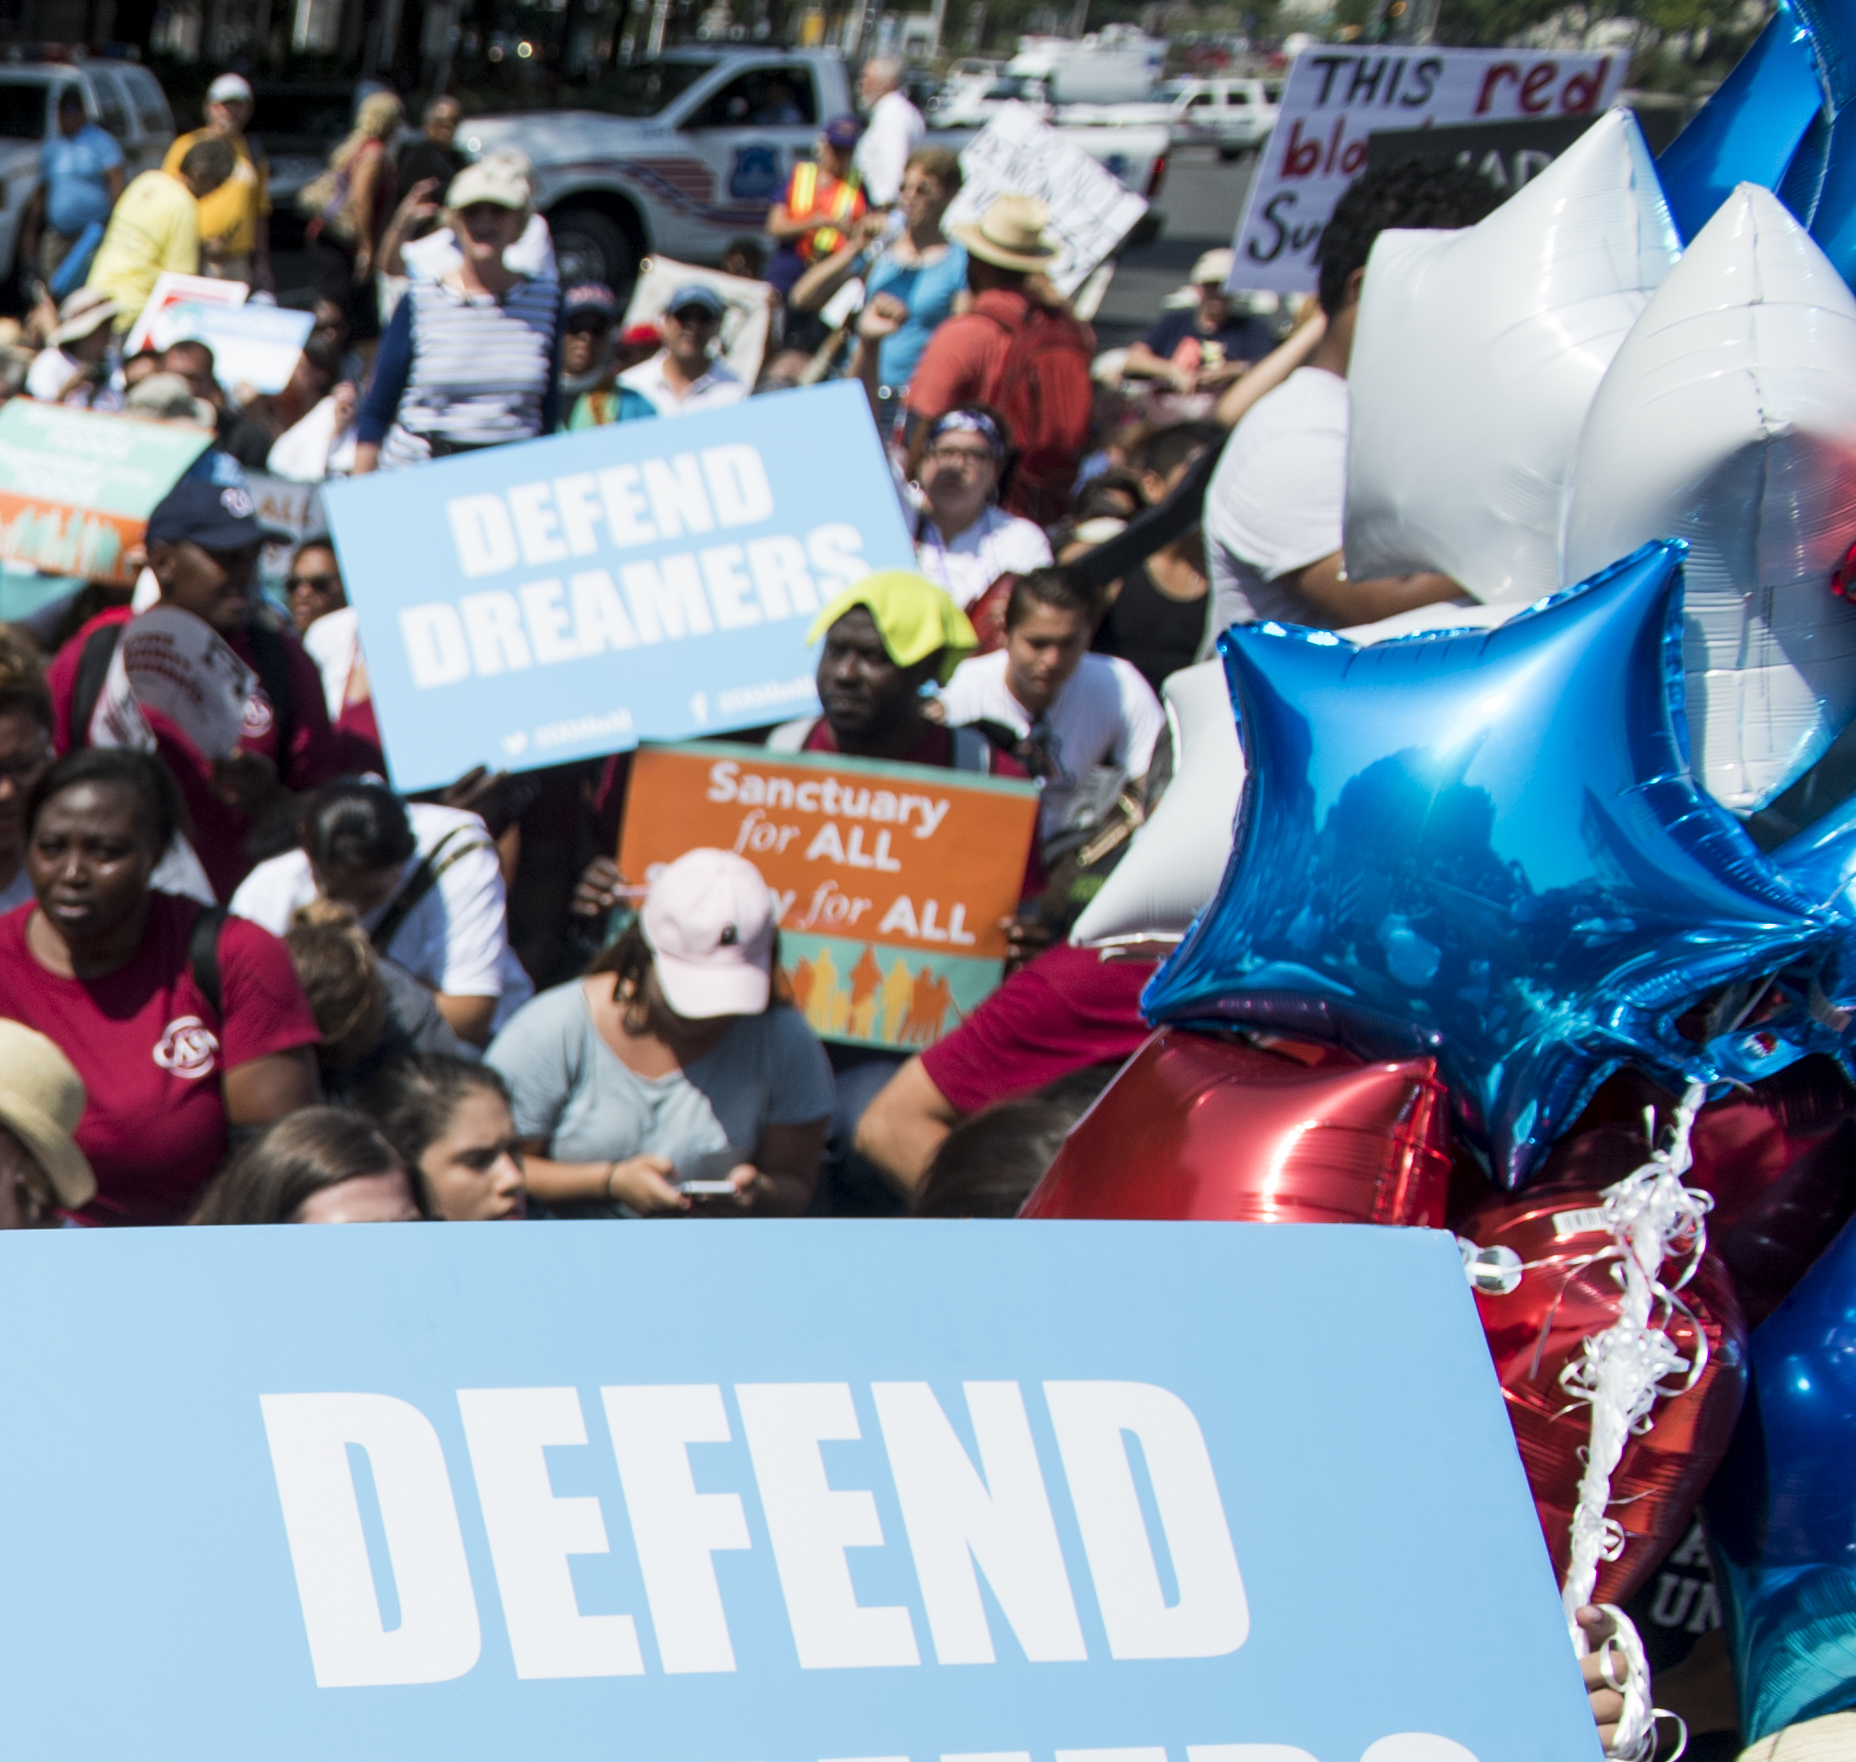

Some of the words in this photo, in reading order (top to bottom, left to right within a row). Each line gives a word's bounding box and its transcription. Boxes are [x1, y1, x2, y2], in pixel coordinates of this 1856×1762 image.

[1310, 56, 1445, 107] THIS
[1475, 55, 1612, 115] red
[447, 443, 774, 578] DEFEND
[400, 523, 874, 690] DREAMERS
[706, 761, 950, 839] Sanctuary
[732, 809, 799, 854] for
[805, 822, 901, 872] ALL
[797, 879, 872, 930] for
[879, 895, 976, 945] ALL
[260, 1380, 1250, 1687] DEFEND
